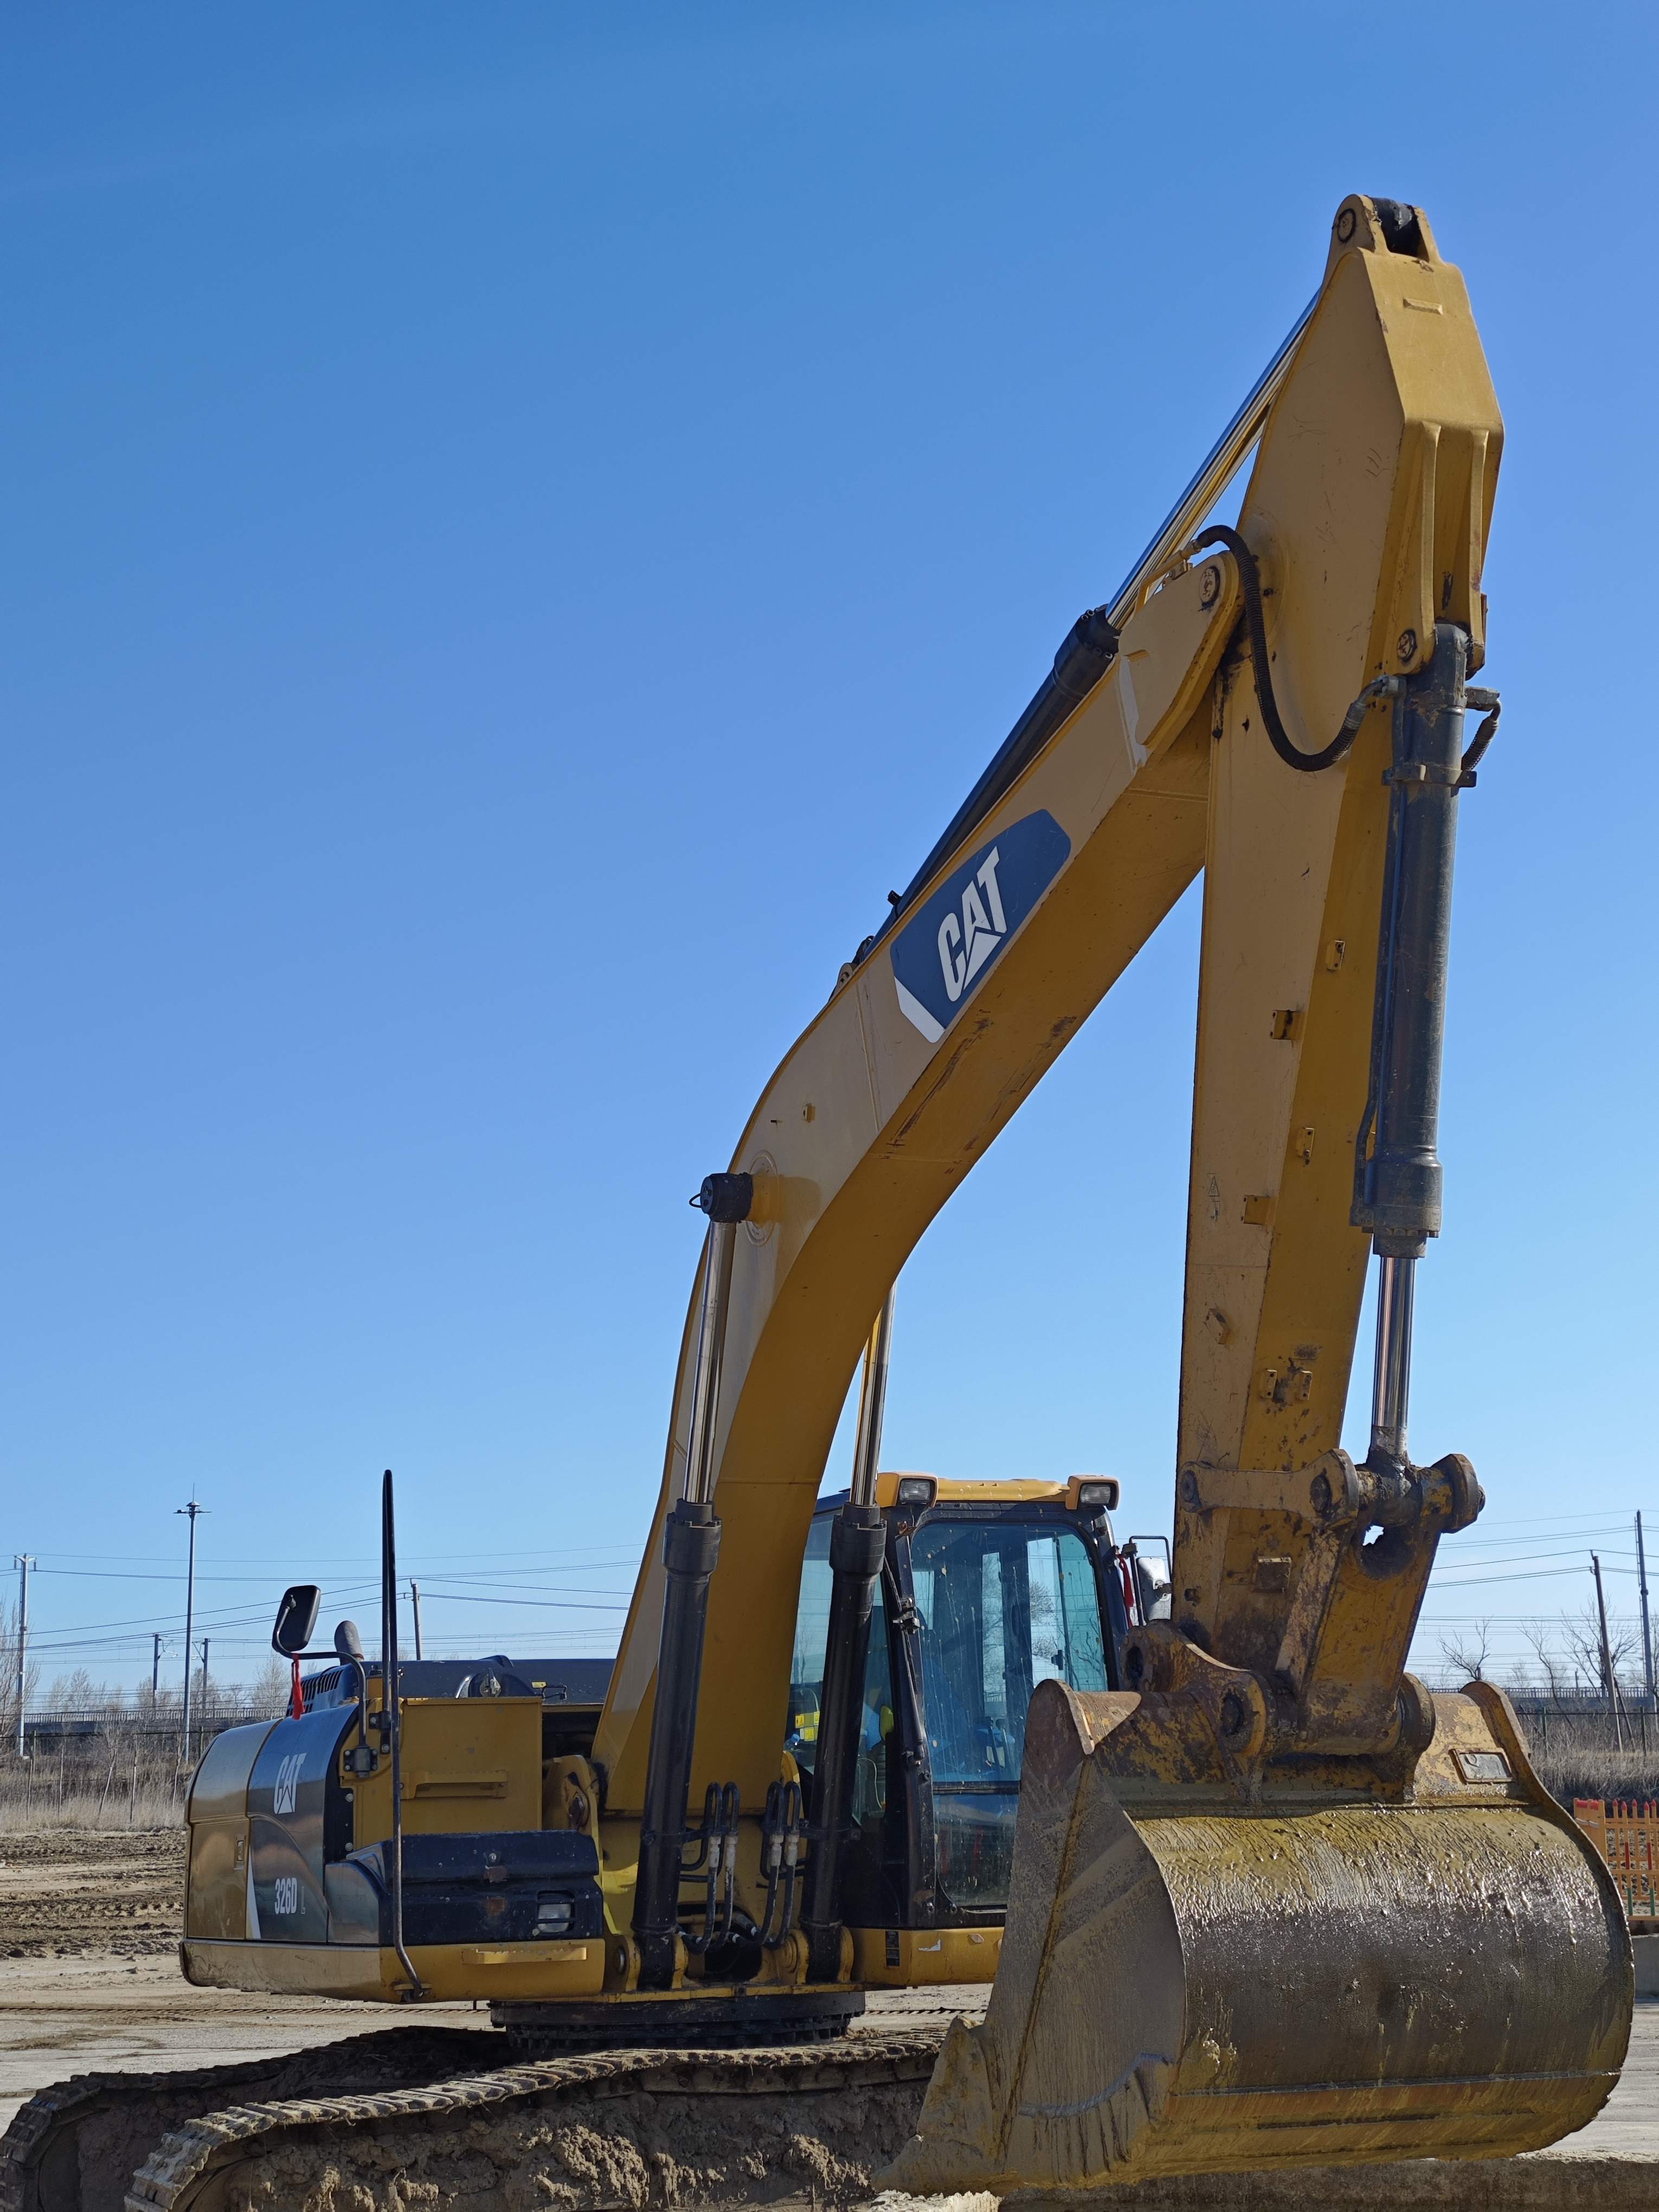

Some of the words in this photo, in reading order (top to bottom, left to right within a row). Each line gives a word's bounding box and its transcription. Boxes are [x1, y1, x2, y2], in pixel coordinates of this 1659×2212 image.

[937, 845, 1007, 1002] CAT
[273, 1752, 307, 1814] CAT
[274, 1877, 298, 1914] 326D
